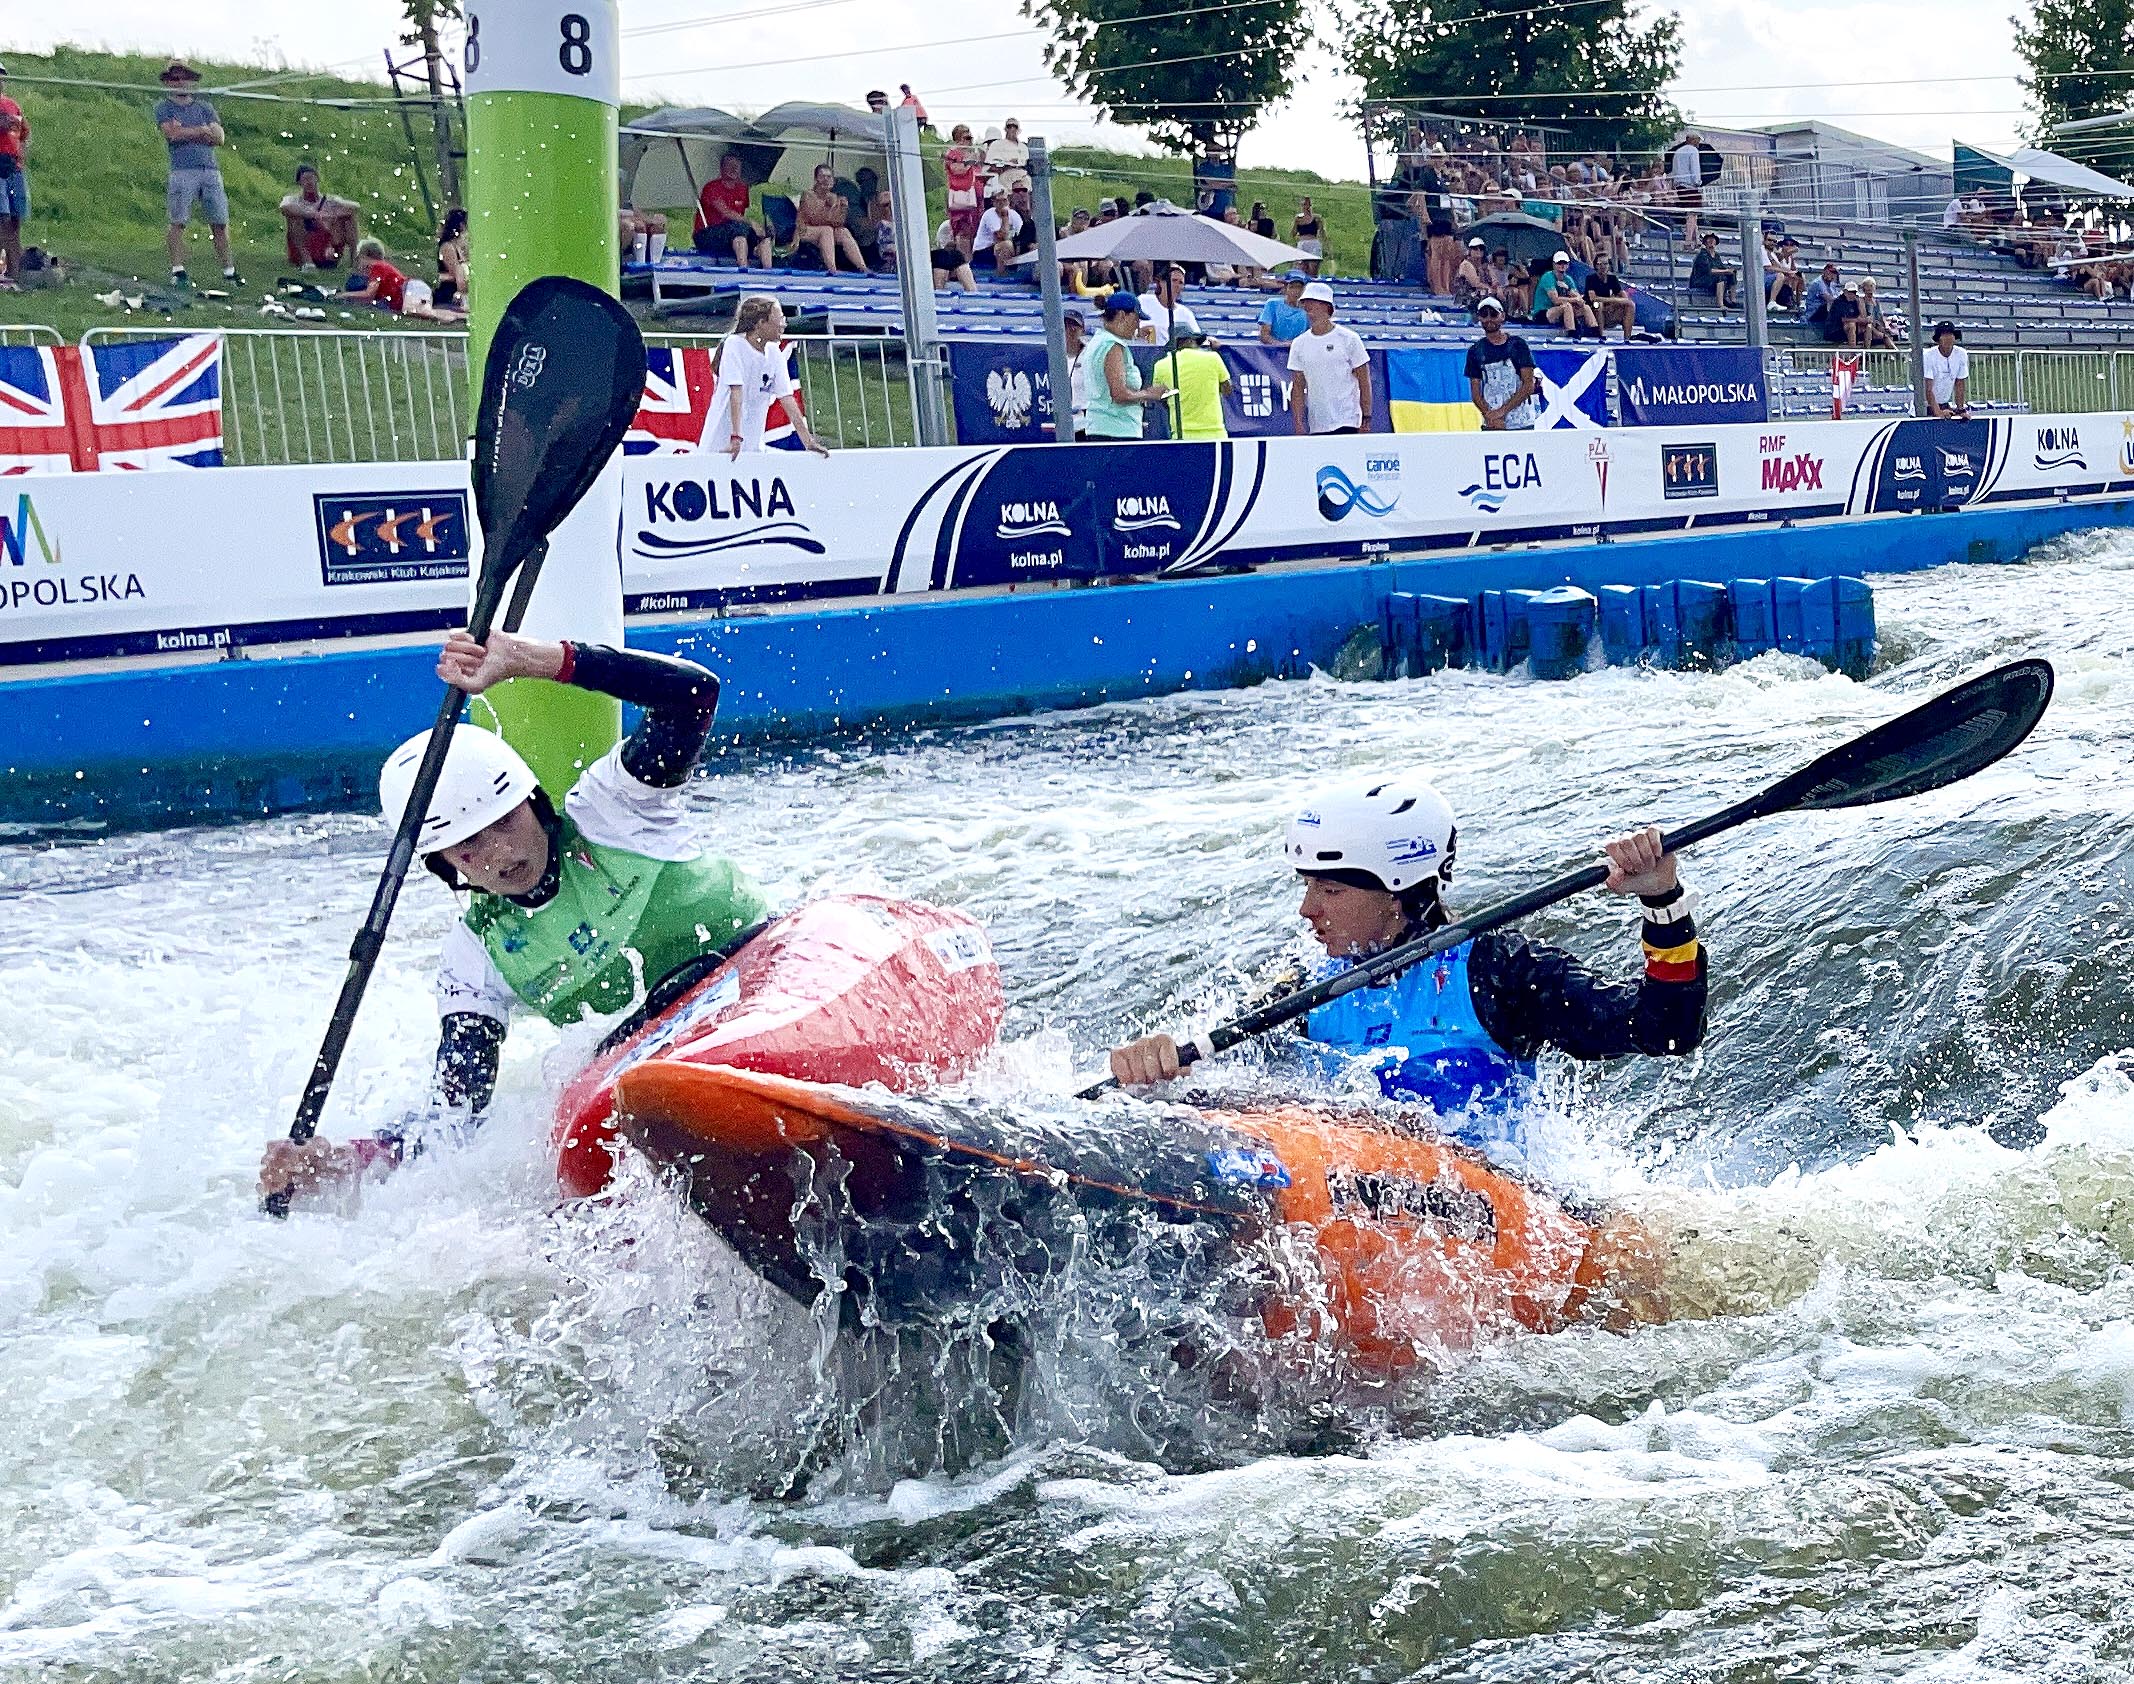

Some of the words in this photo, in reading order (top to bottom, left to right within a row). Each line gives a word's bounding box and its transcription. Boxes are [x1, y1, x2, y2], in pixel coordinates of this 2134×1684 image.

[559, 13, 593, 75] 8
[1652, 383, 1758, 405] MAŁOPOLSKA
[1760, 435, 1786, 453] RMF
[2037, 427, 2079, 451] KOLNA
[1366, 459, 1400, 471] canoe
[1484, 453, 1542, 490] ECA
[645, 477, 795, 523] KOLNA
[1116, 496, 1170, 516] KOLNA
[1001, 501, 1060, 523] KOLNA
[1010, 549, 1063, 568] kolna.pl
[1124, 541, 1170, 559] kolna.pl
[391, 567, 417, 578] Klub
[420, 565, 468, 578] Kajakow
[640, 595, 688, 610] #kolna
[156, 628, 231, 650] kolna.pl
